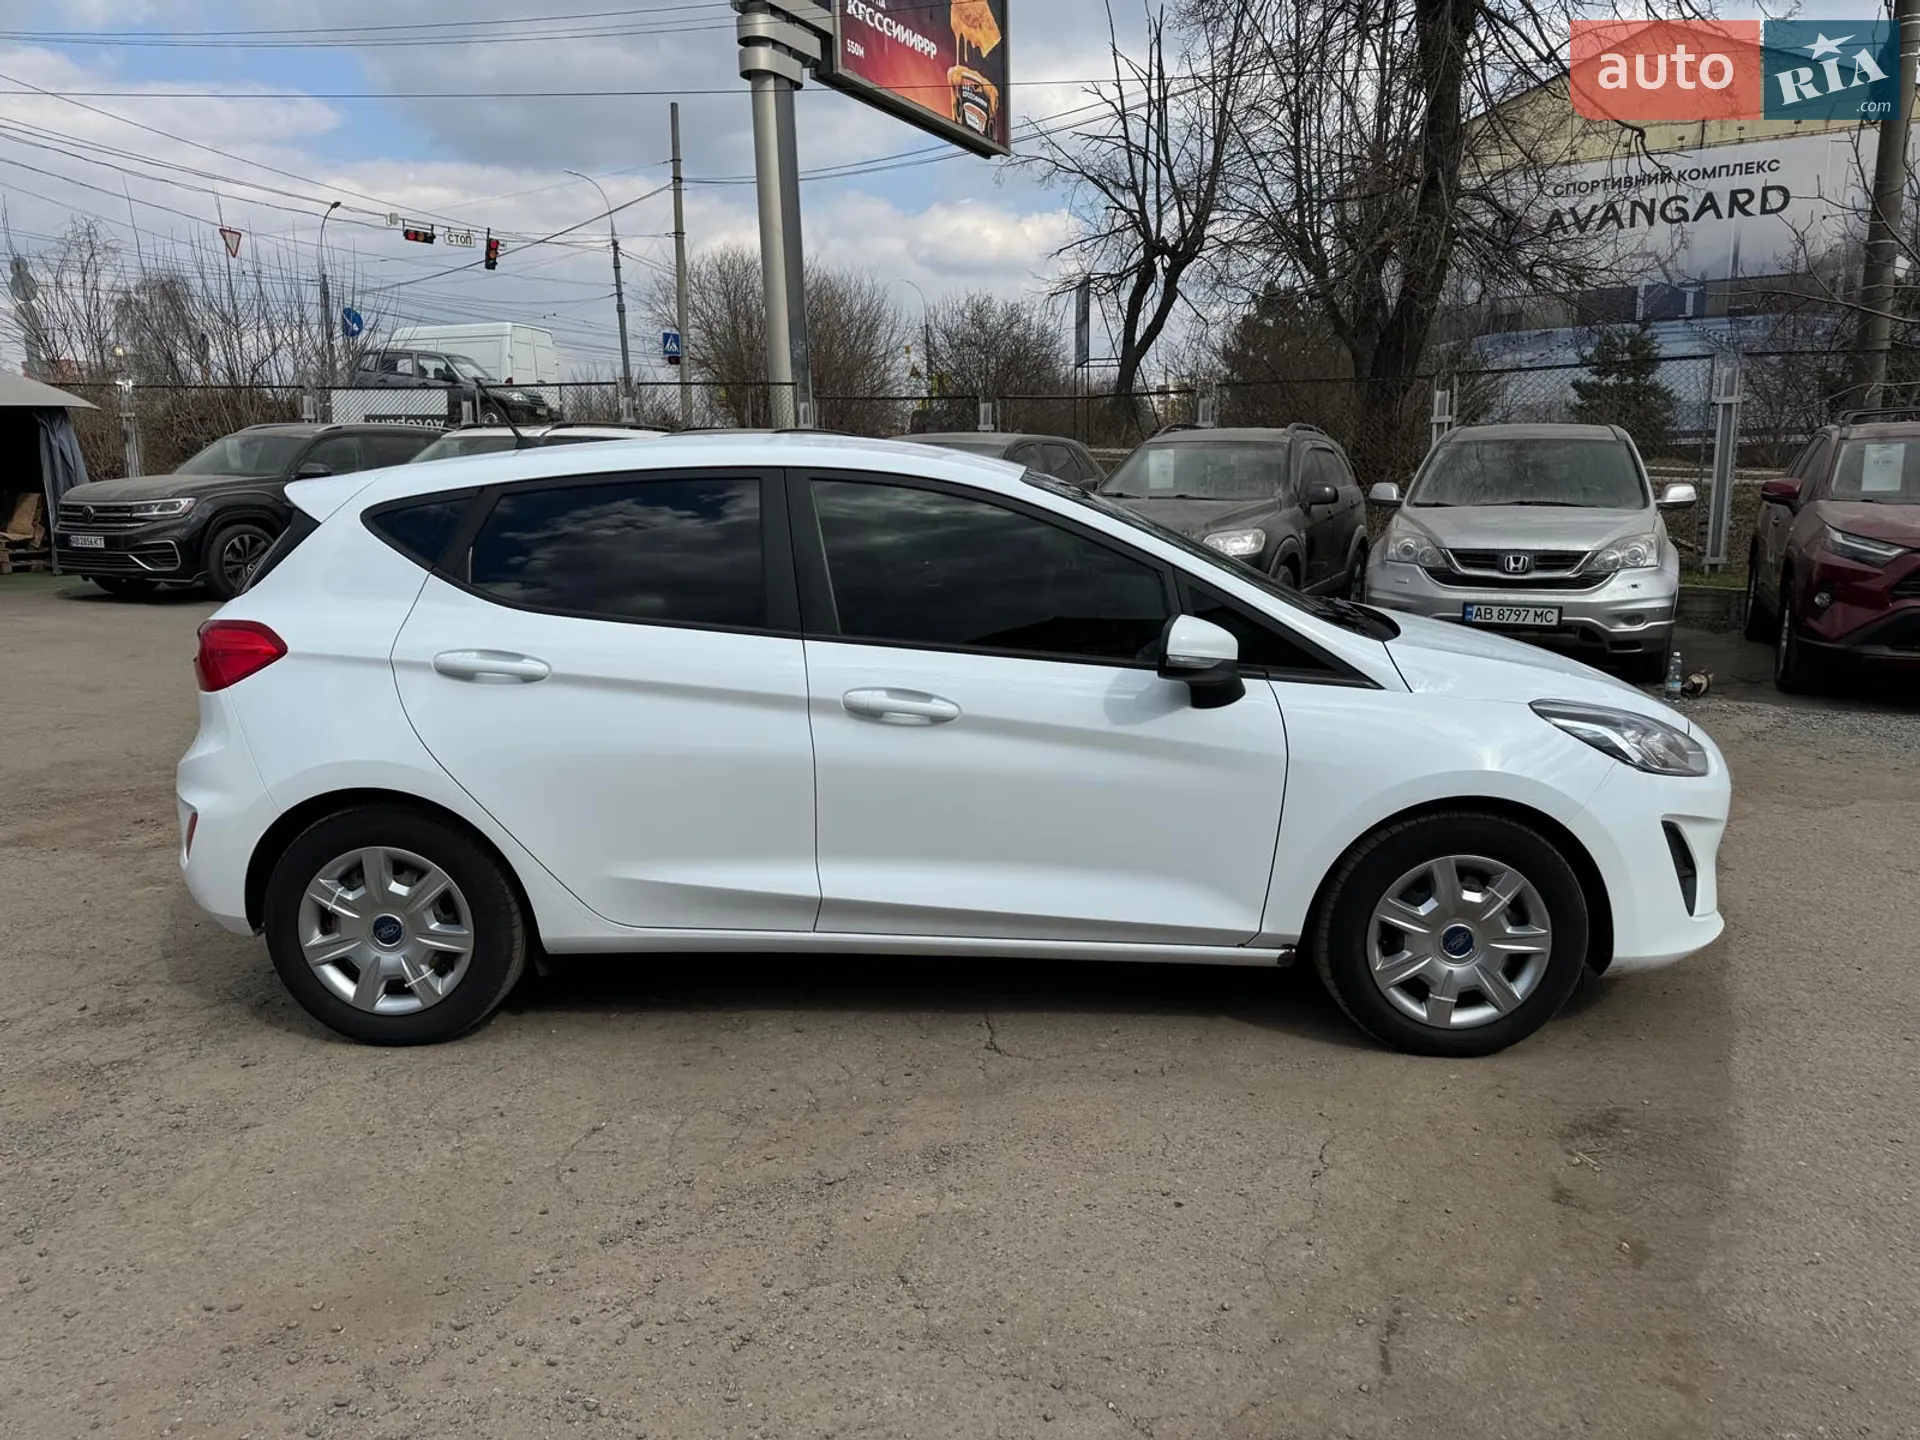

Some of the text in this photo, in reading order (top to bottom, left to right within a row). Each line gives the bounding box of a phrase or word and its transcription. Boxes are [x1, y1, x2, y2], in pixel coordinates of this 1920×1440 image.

[1553, 159, 1781, 197] СПОРТИВНИЙ КОМПЛЕКС
[1543, 184, 1791, 235] AVANGARD
[1473, 607, 1493, 620] AB
[1497, 608, 1530, 622] 8797
[1533, 609, 1554, 623] MC
